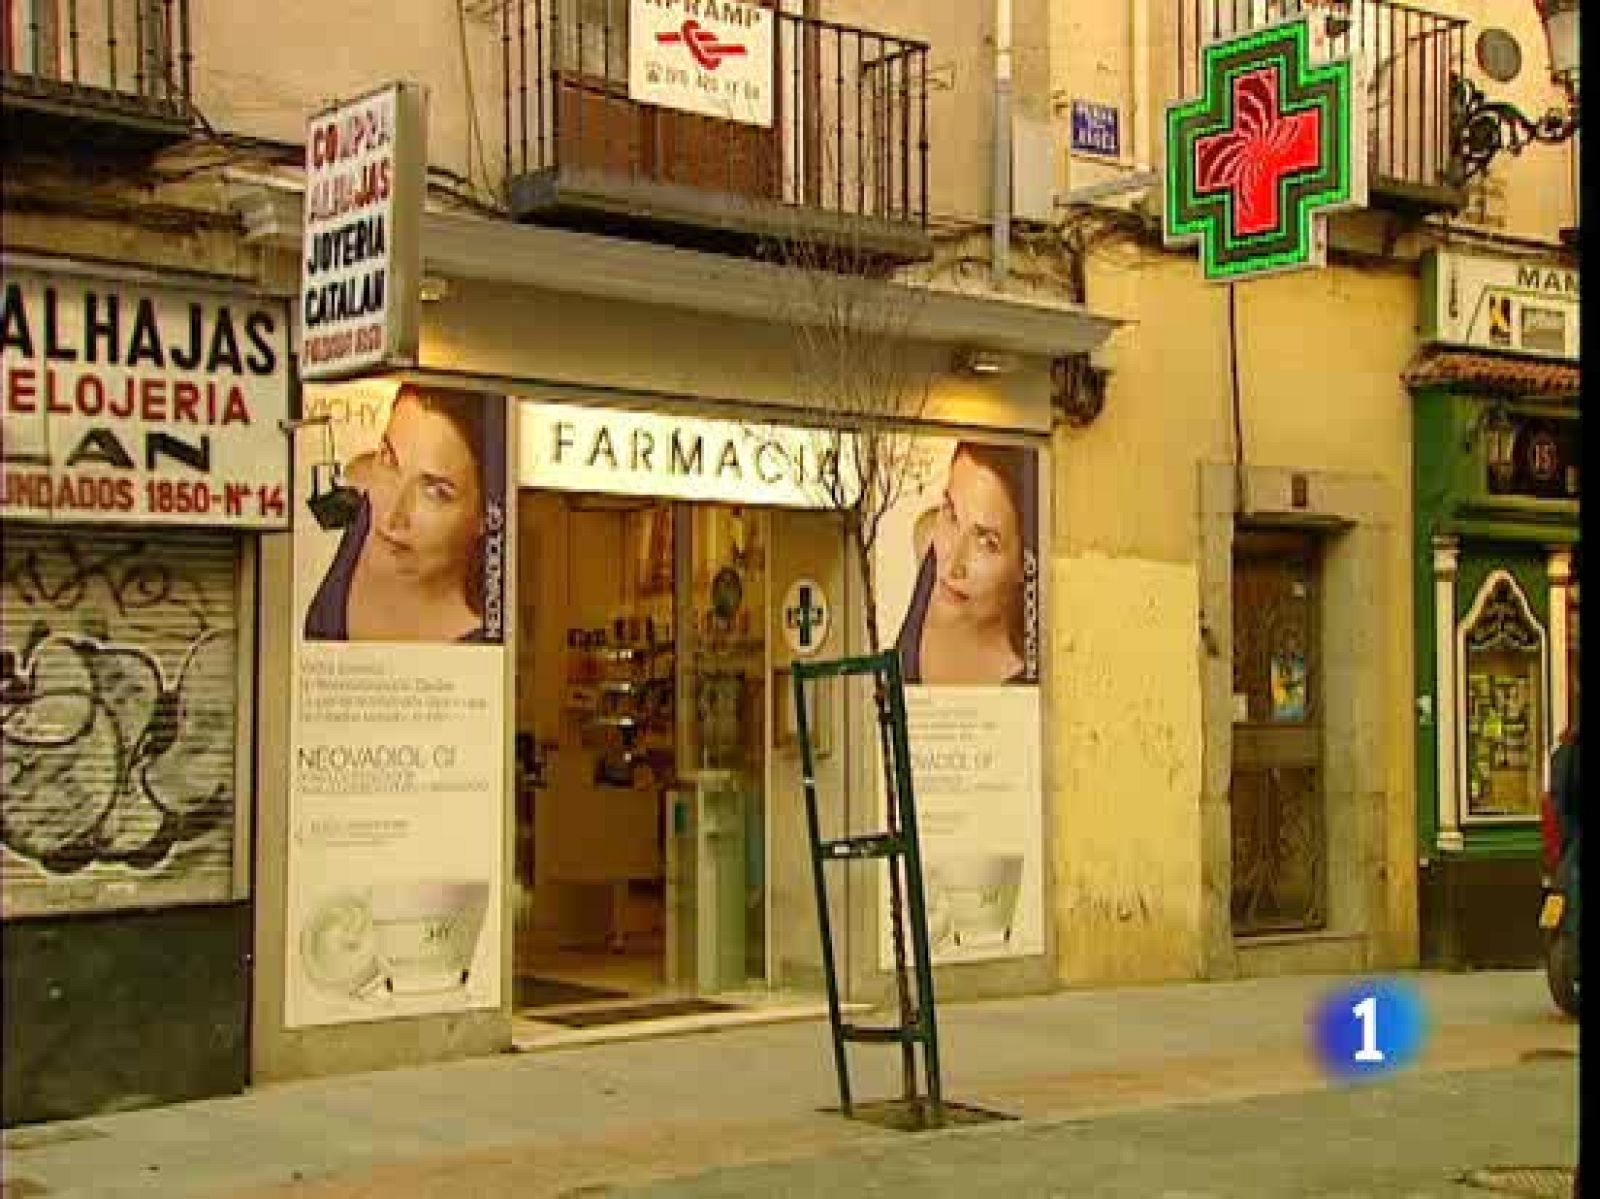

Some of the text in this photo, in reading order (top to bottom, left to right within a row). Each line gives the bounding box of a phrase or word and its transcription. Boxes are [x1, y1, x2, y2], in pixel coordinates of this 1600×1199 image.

[0, 283, 276, 375] ALHAJAS
[8, 369, 251, 425] ELOJERIA
[550, 419, 838, 492] FARMACIA
